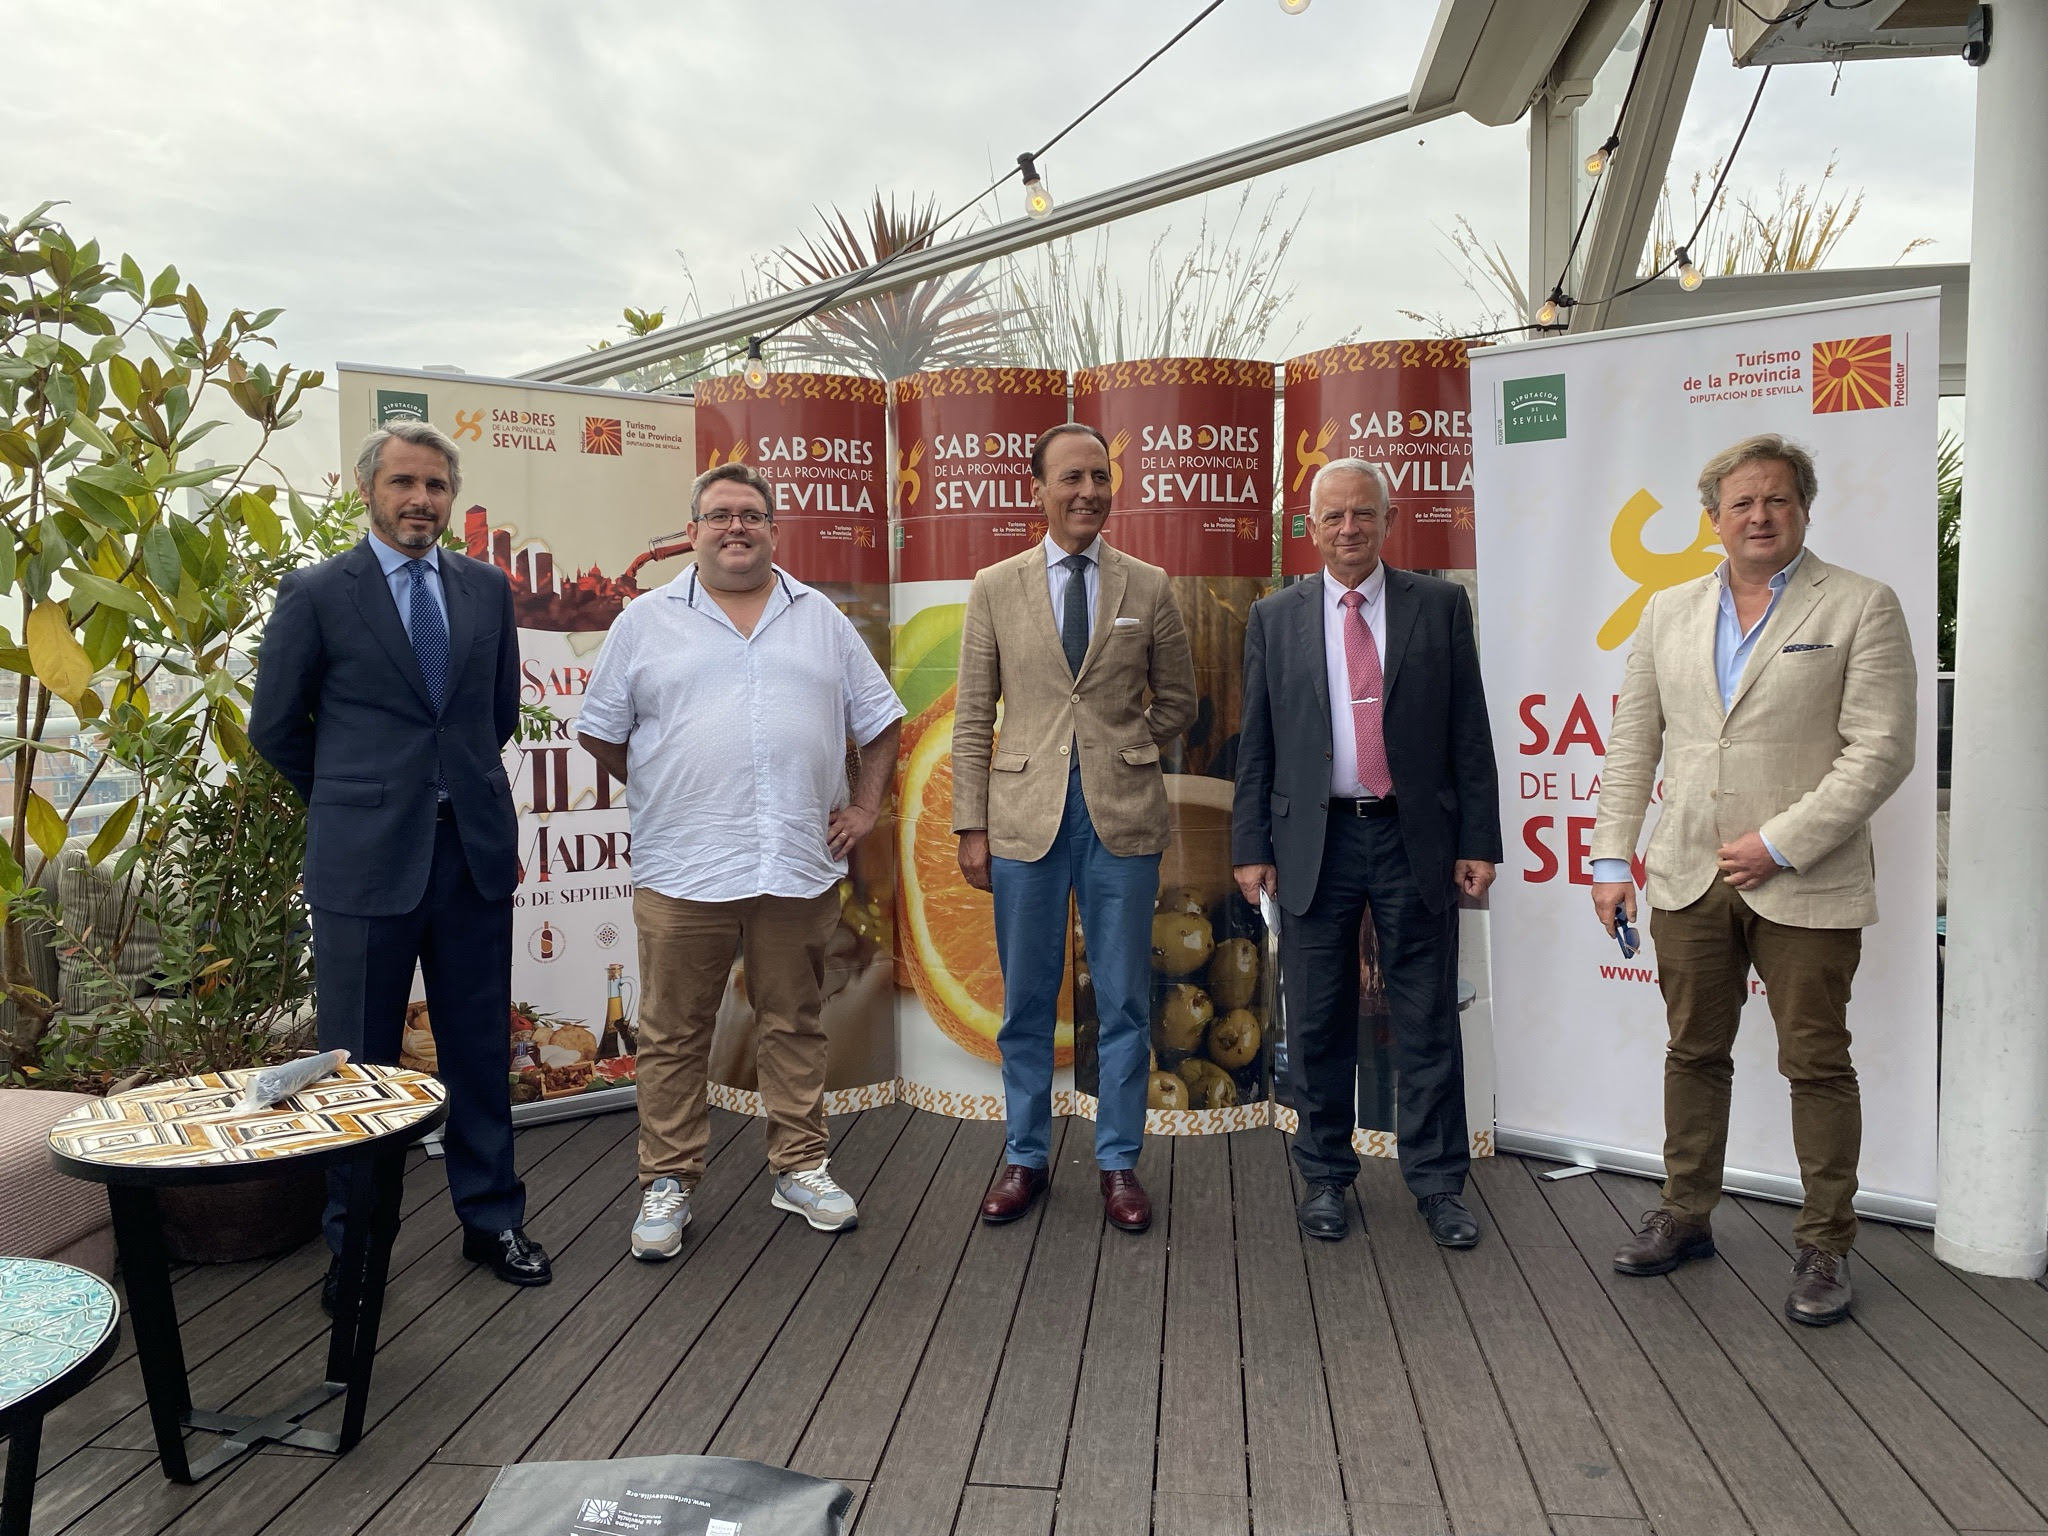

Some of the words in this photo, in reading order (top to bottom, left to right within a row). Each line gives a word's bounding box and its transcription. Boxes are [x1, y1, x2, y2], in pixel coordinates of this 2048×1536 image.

[1736, 350, 1800, 367] Turismo
[1683, 377, 1702, 391] de
[1708, 375, 1722, 388] la
[1729, 366, 1800, 386] Provincia
[1894, 362, 1904, 407] Prodetur
[1511, 392, 1558, 406] DIPUTACION
[1690, 390, 1748, 404] DIPUTACION
[1751, 388, 1763, 398] DE
[1766, 385, 1804, 396] SEVILLA
[383, 403, 423, 413] DIPUTACION
[492, 409, 555, 427] SABORES
[626, 421, 656, 431] Turismo
[1513, 414, 1558, 425] SEVILLA
[512, 426, 546, 434] PROVINCIA
[626, 430, 635, 438] de
[648, 433, 682, 442] Provincia
[493, 433, 556, 452] SEVILLA
[934, 433, 1037, 459] SABORE
[1141, 425, 1259, 452] SABORES
[759, 436, 873, 465] SABORES
[1350, 445, 1364, 458] DE
[1369, 445, 1384, 457] LA
[1389, 443, 1460, 456] PROVINCIA
[1464, 444, 1472, 455] D
[935, 465, 947, 477] DE
[951, 464, 964, 476] LA
[968, 463, 1033, 475] PROVINCIA
[1142, 457, 1156, 470] DE
[1160, 456, 1175, 468] LA
[1180, 456, 1243, 469] PROVINCIA
[1246, 458, 1258, 470] DE
[759, 467, 773, 478] DE
[777, 467, 791, 478] LA
[795, 467, 858, 480] PROVINCIA
[861, 470, 873, 481] DE
[1141, 474, 1259, 504] SEVILLA
[771, 483, 874, 513] EVILLA
[1520, 772, 1558, 800] DE
[1571, 773, 1600, 800] LA
[532, 891, 554, 906] DE
[626, 1490, 710, 1508] www.turismosevilla.org
[615, 1521, 639, 1530] Turismo
[617, 1515, 644, 1524] Provincia
